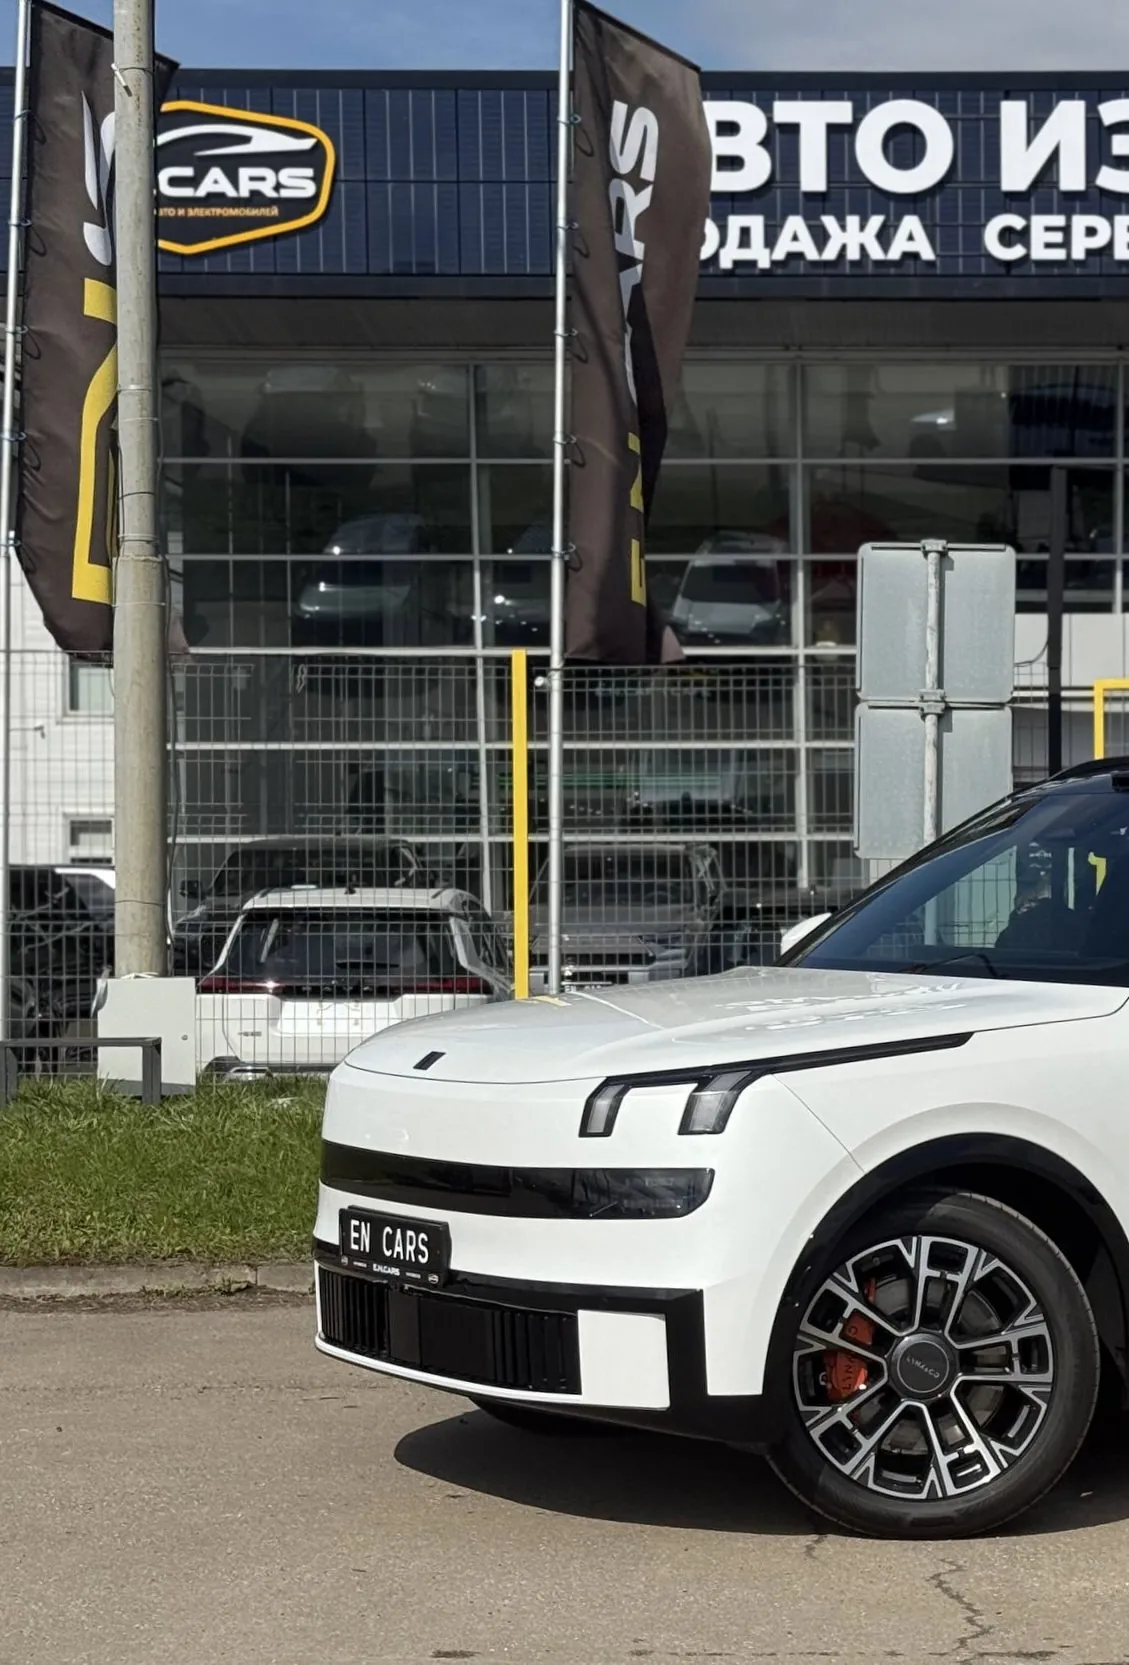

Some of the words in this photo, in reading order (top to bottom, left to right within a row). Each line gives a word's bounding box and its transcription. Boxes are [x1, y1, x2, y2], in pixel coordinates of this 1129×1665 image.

[702, 98, 954, 193] ВТО
[157, 166, 317, 198] CARS
[699, 214, 936, 269] ДАЖА
[350, 1219, 371, 1253] EN
[382, 1226, 429, 1264] CARS
